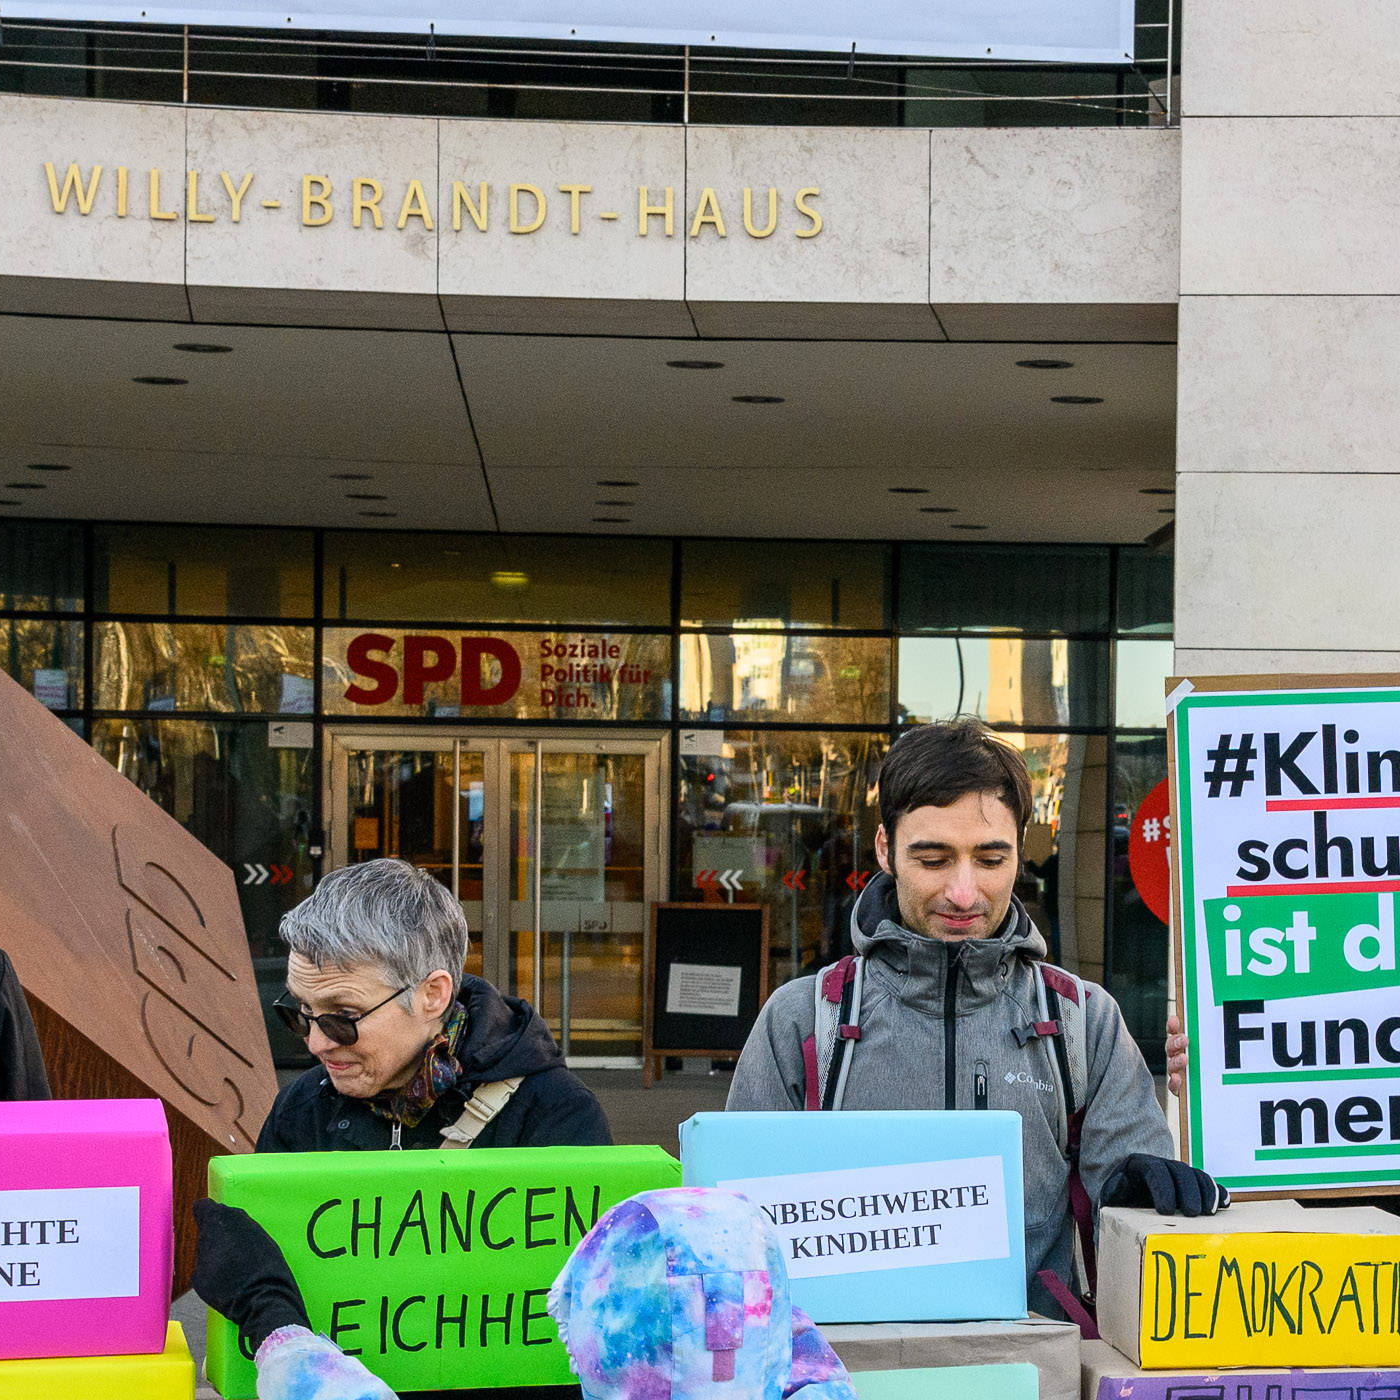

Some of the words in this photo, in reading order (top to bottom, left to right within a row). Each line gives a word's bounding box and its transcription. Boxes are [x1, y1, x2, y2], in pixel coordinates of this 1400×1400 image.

[45, 162, 823, 239] WILLY-BRANDT-HAUS
[343, 633, 522, 706] SPD
[540, 639, 620, 659] Soziale
[540, 664, 611, 684] Politik
[619, 664, 650, 684] für
[540, 688, 596, 708] Dich.
[1222, 905, 1316, 976] ist
[307, 1184, 600, 1260] CHANCEN
[760, 1184, 989, 1226] NBESCHWERTE
[790, 1224, 942, 1259] KINDHEIT
